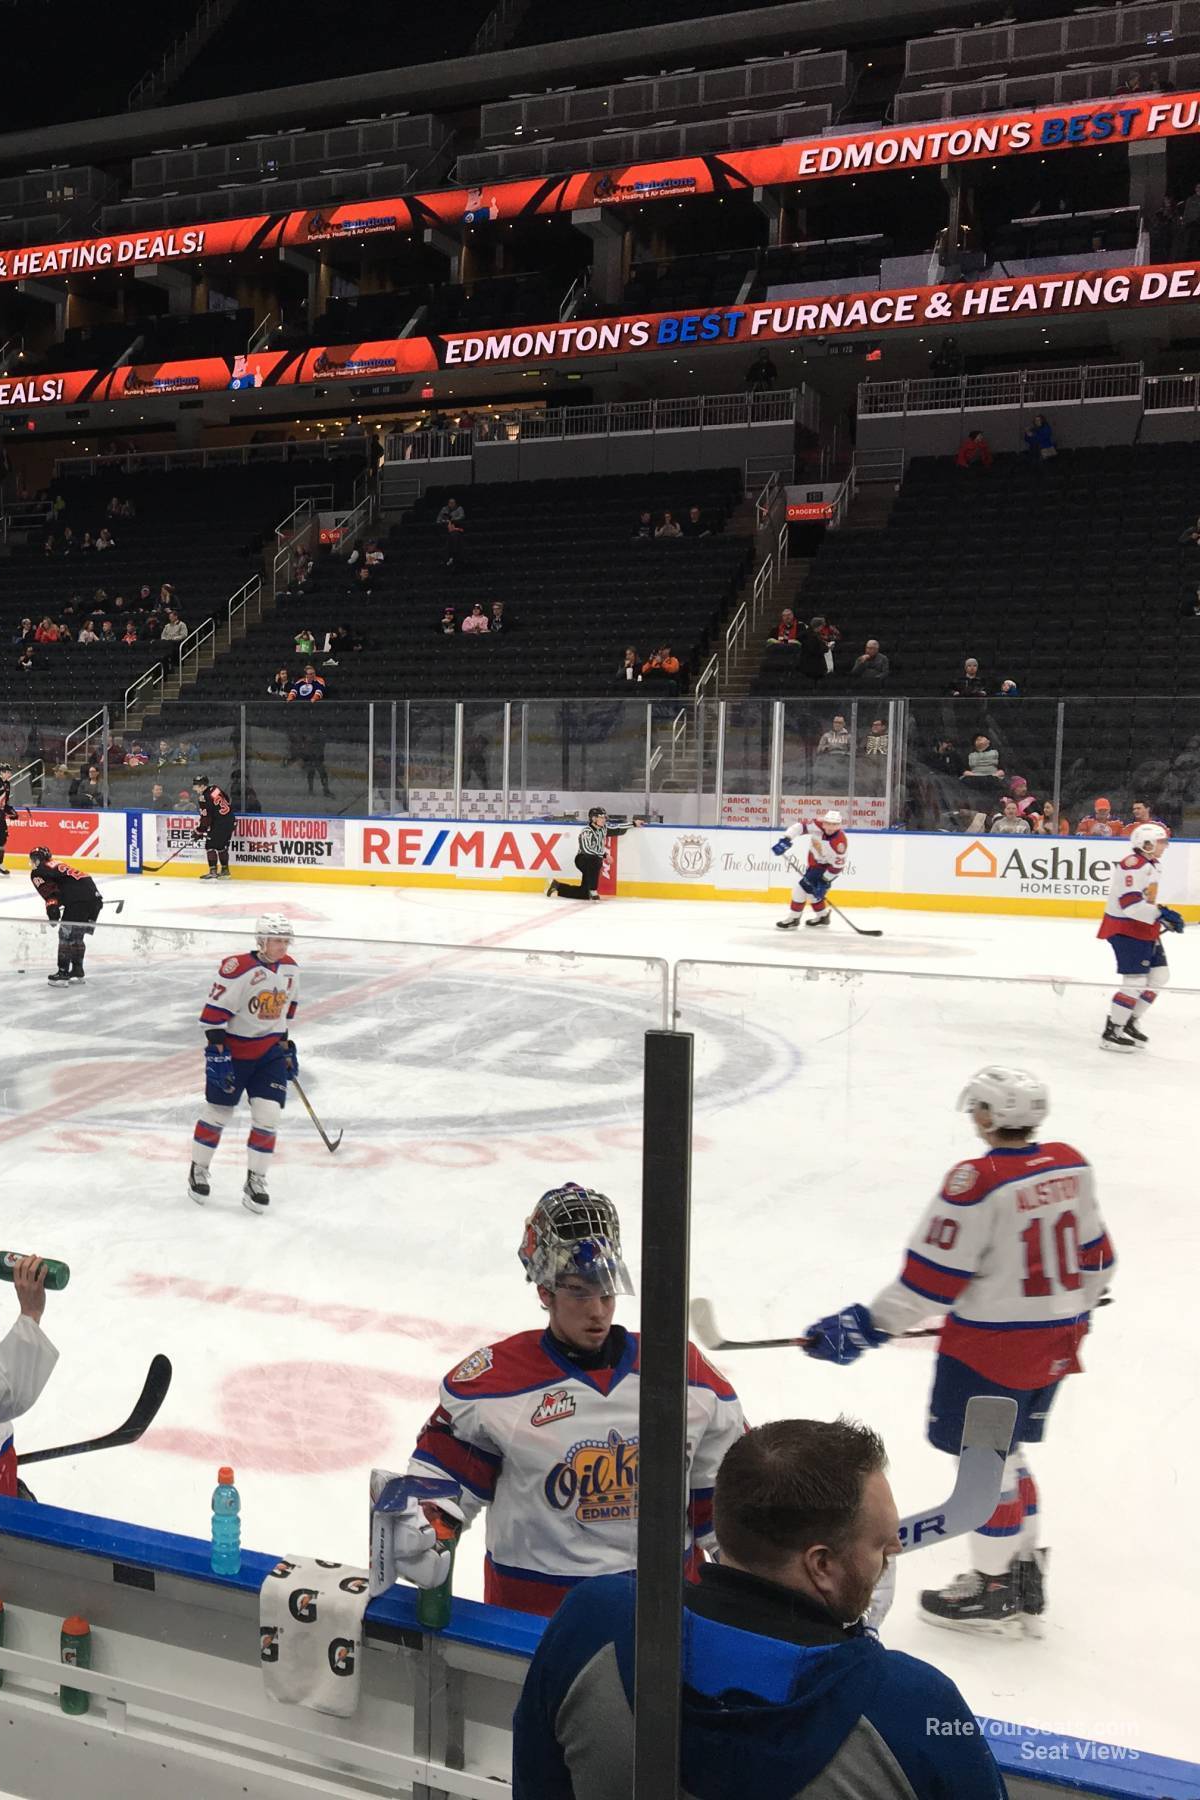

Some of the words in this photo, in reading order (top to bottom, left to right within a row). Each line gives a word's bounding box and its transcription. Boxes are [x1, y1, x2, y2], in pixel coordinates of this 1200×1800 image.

[798, 122, 1033, 175] EDMONTON'S
[1041, 108, 1143, 145] BEST
[12, 243, 113, 276] HEATING
[117, 231, 206, 261] DEALS!
[445, 321, 651, 364] EDMONTON'S
[657, 310, 745, 345] BEST
[751, 294, 916, 335] FURNACE
[924, 291, 953, 319] &
[961, 274, 1131, 316] HEATING
[30, 820, 49, 828] Lives.
[65, 820, 90, 830] CLAC
[727, 815, 750, 823] BRICK
[270, 821, 277, 836] &
[281, 820, 327, 840] MCCORD
[235, 854, 271, 864] MORNING
[273, 854, 296, 864] SHOW
[279, 841, 333, 857] WORST
[362, 827, 562, 872] RE/MAX
[721, 853, 740, 872] The
[743, 853, 781, 873] Sutton
[1125, 875, 1134, 887] 8
[924, 1215, 960, 1251] 10
[1020, 1209, 1083, 1298] 10
[539, 1398, 576, 1419] WHL
[288, 1588, 319, 1624] G
[328, 1637, 355, 1677] G
